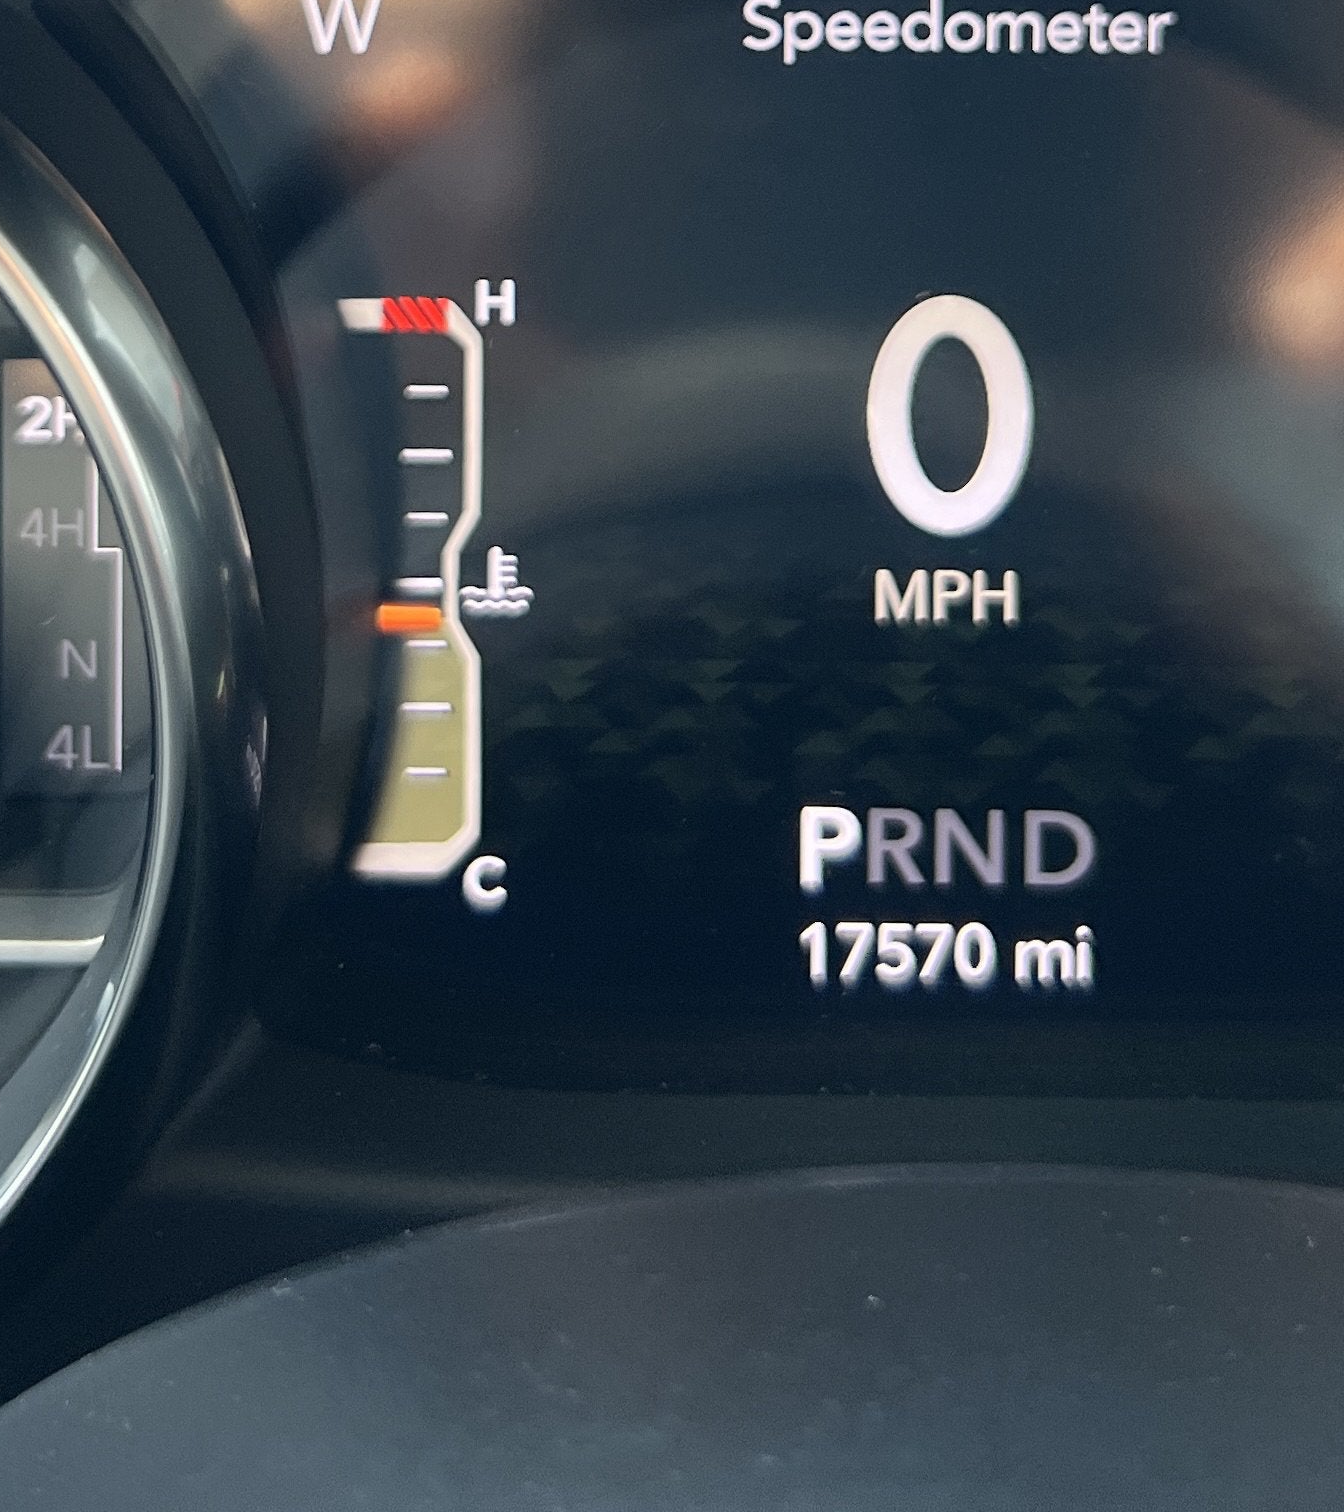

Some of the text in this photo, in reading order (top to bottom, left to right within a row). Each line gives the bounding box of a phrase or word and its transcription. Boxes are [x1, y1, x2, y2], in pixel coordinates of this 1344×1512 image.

[475, 279, 515, 325] H
[867, 295, 1034, 537] 0
[20, 508, 84, 547] 4H
[875, 569, 1017, 623] MPH
[61, 639, 97, 678] N
[47, 725, 109, 770] 4L
[462, 855, 507, 908] C
[800, 922, 1092, 985] 17570 mi
